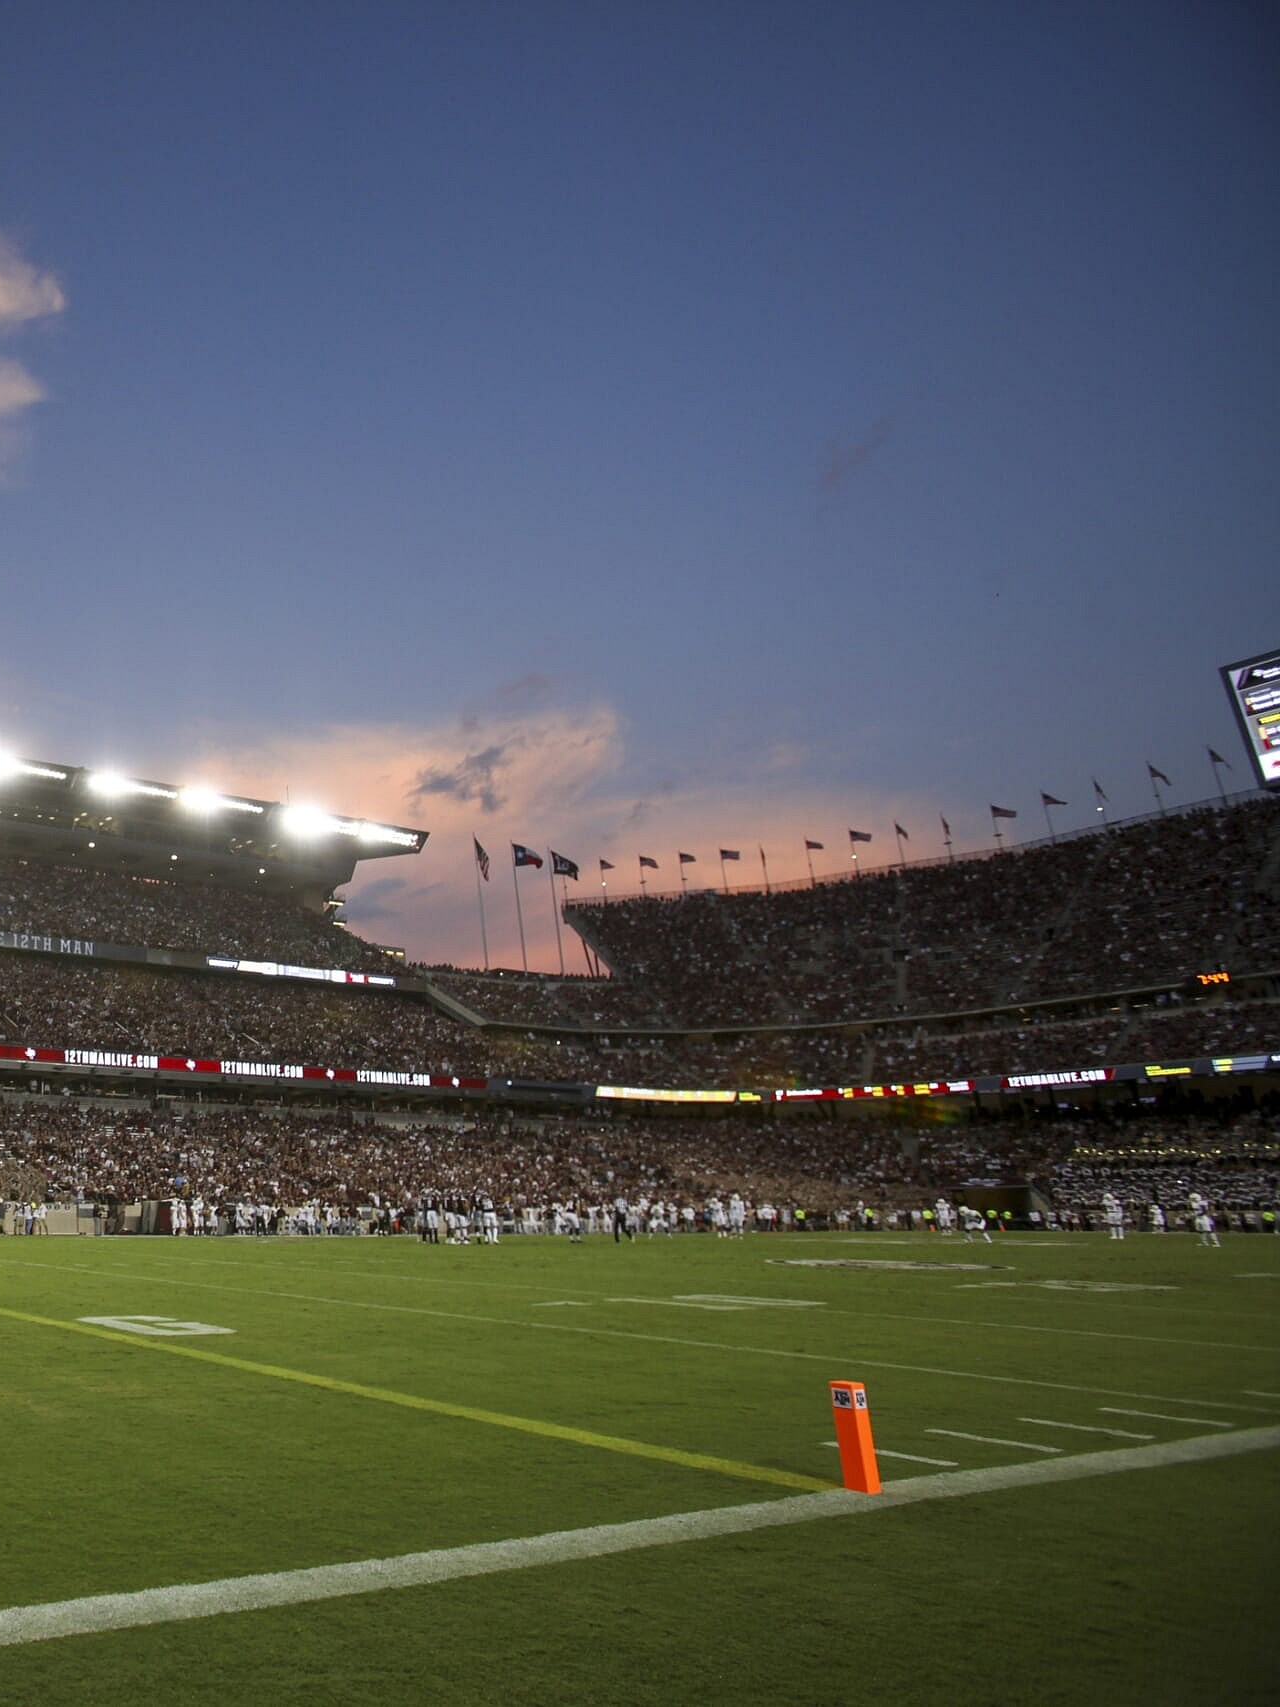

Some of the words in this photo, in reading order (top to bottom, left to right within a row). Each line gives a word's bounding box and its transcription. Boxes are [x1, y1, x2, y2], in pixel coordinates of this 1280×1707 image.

[12, 933, 52, 952] 12TH
[59, 938, 95, 956] MAN
[64, 1050, 158, 1069] 12THMANLIVE.COM
[220, 1061, 303, 1078] 12THMANLIVE.COM
[356, 1070, 431, 1086] 12THMANLIVE.COM
[1008, 1070, 1107, 1087] 12THMANLIVE.COM
